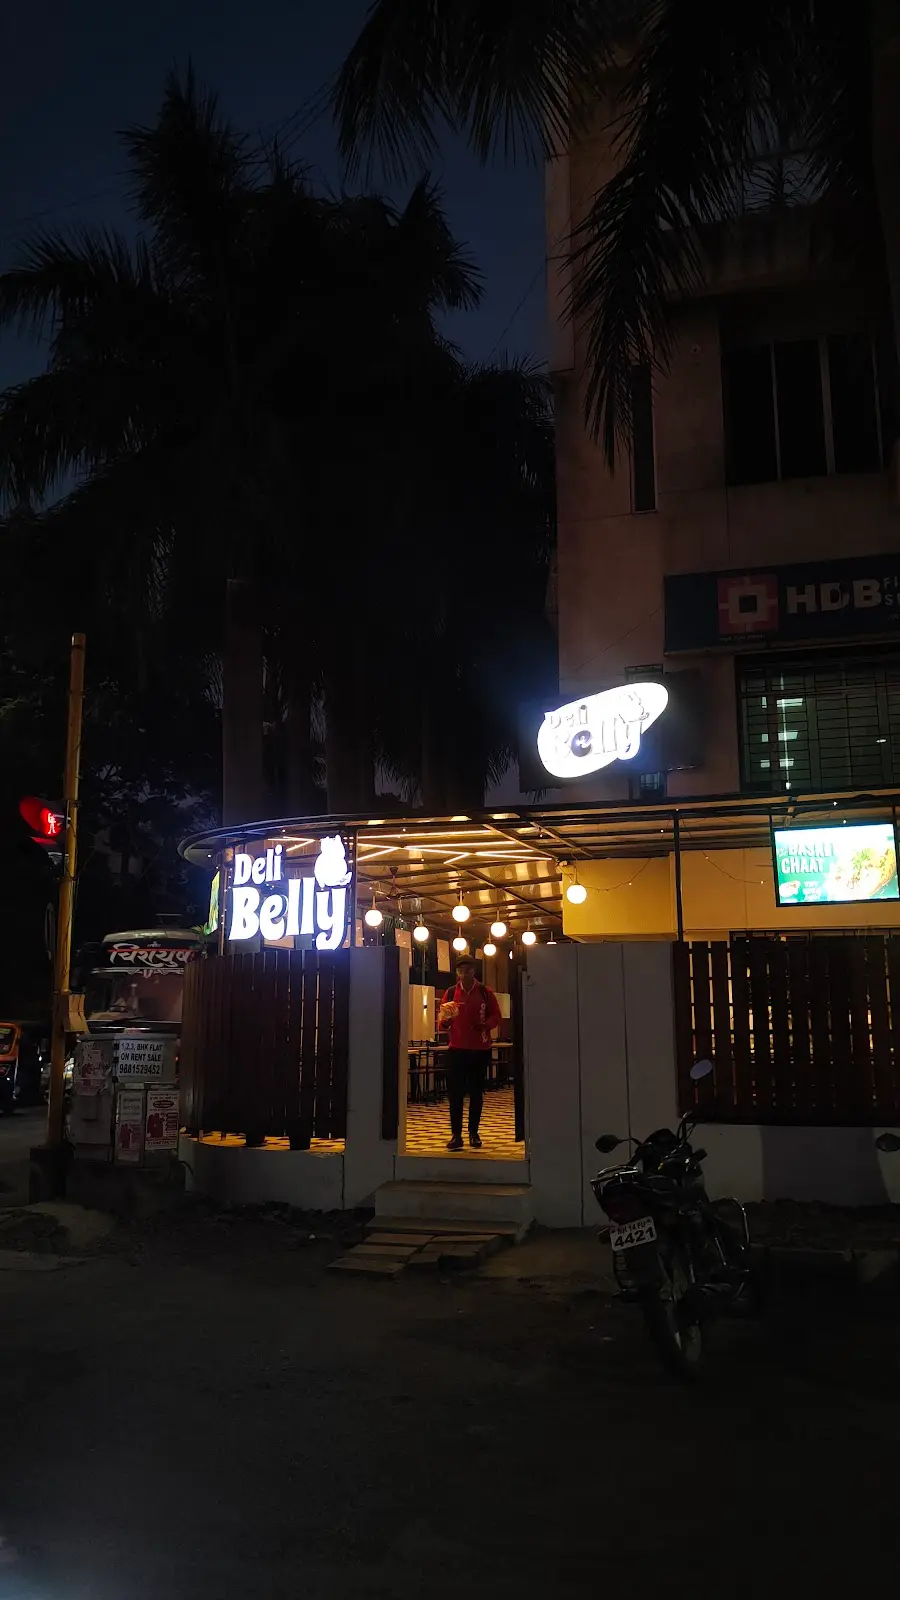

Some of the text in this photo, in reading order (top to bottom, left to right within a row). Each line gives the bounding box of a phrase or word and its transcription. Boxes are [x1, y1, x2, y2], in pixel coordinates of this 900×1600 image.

[785, 577, 882, 614] HDB
[233, 844, 283, 886] Deli
[781, 855, 824, 874] CHAAT
[228, 876, 347, 951] Belly
[120, 1052, 161, 1062] ON RENT SALE
[137, 1043, 149, 1051] BHK
[149, 1044, 163, 1052] FLAT
[614, 1226, 654, 1247] 4421
